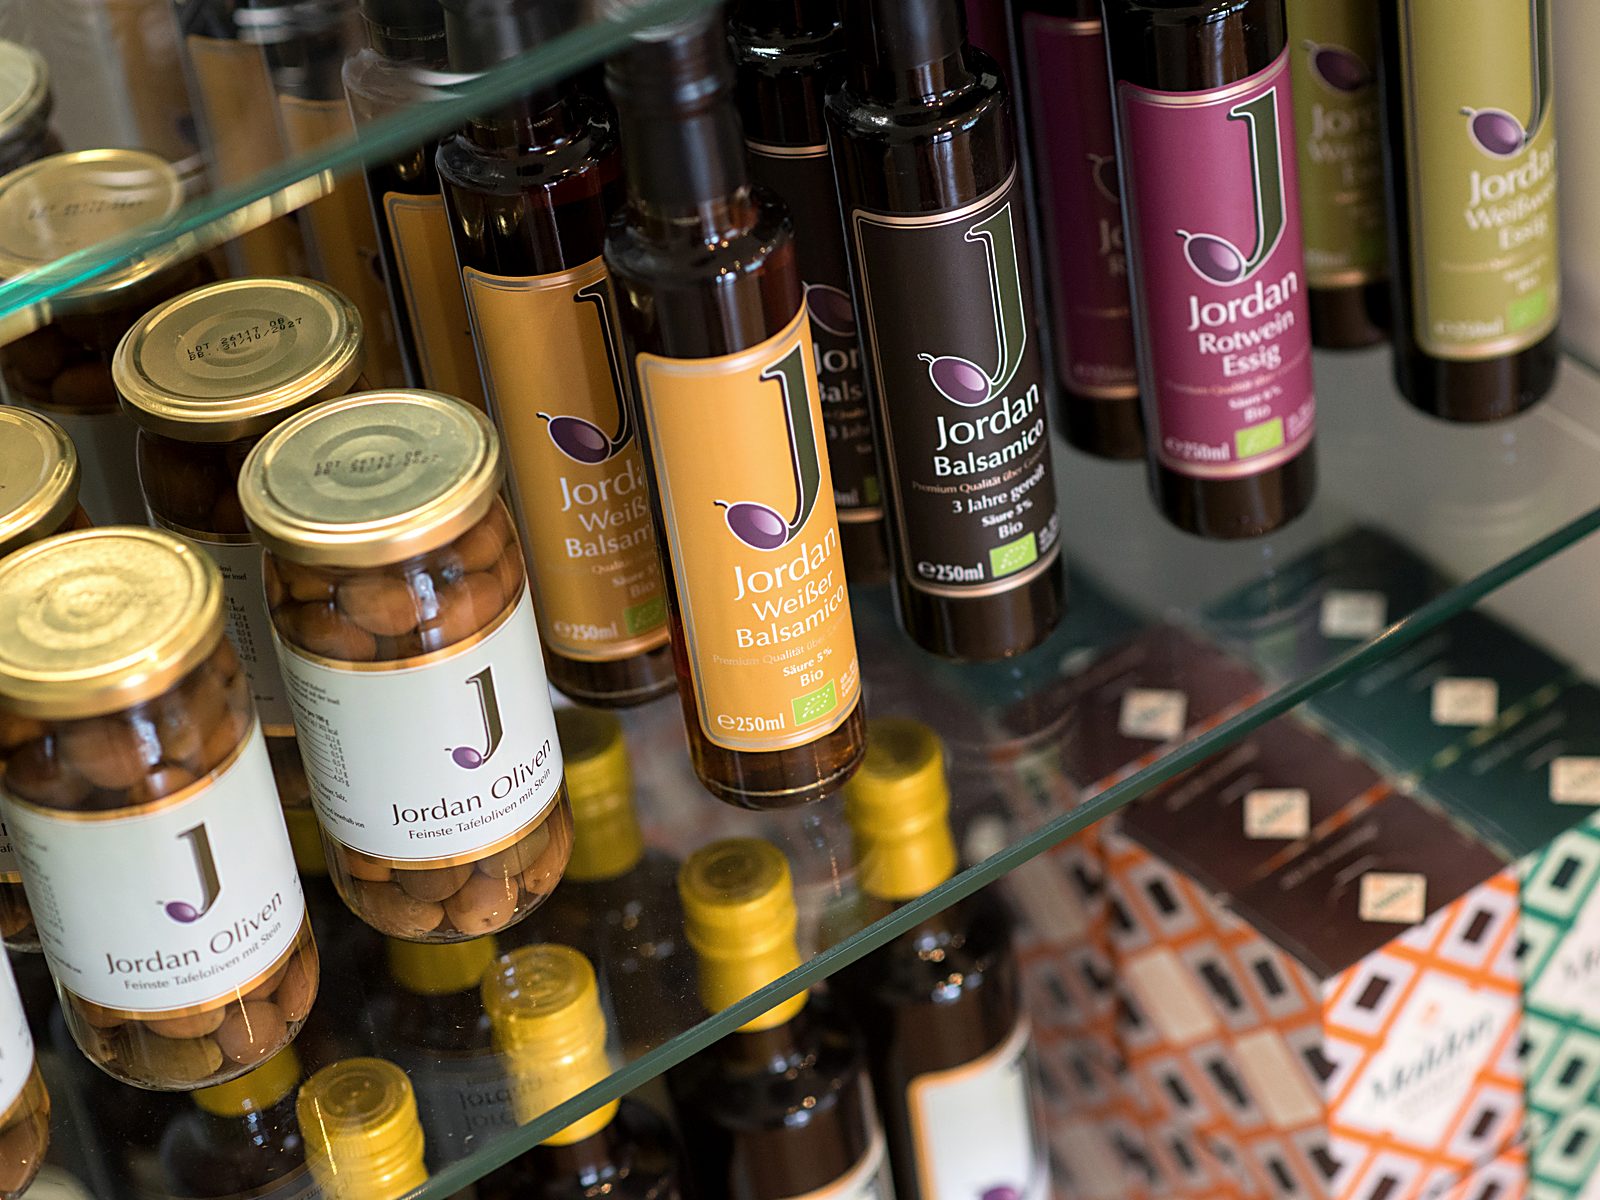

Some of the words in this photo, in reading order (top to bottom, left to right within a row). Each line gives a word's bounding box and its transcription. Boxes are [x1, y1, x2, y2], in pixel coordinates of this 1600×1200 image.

[1188, 271, 1297, 332] Jordan
[187, 342, 209, 355] LOT
[1198, 310, 1294, 354] Rotwein
[1222, 345, 1281, 377] Essig
[936, 383, 1039, 451] Jordan
[934, 418, 1044, 477] Balsamico
[578, 496, 648, 532] Weiß
[952, 500, 963, 514] 3
[967, 492, 1008, 514] Jahre
[998, 521, 1024, 539] Bio
[734, 527, 836, 601] Jordan
[736, 585, 844, 648] Balsamico
[752, 570, 833, 621] Weißer
[762, 645, 804, 665] Qualität
[782, 658, 815, 677] Säure
[800, 669, 825, 687] Bio
[392, 794, 482, 826] Jordan
[491, 738, 551, 800] Oliven
[408, 827, 453, 840] Feinste
[456, 802, 517, 833] Tafeloliven
[519, 788, 534, 805] mit
[534, 768, 551, 792] Stein
[106, 948, 200, 975] Jordan
[210, 892, 283, 954] Oliven
[124, 979, 169, 991] Feinste
[173, 954, 240, 986] Tafeloliven
[242, 942, 260, 960] mit
[260, 921, 282, 945] Stein
